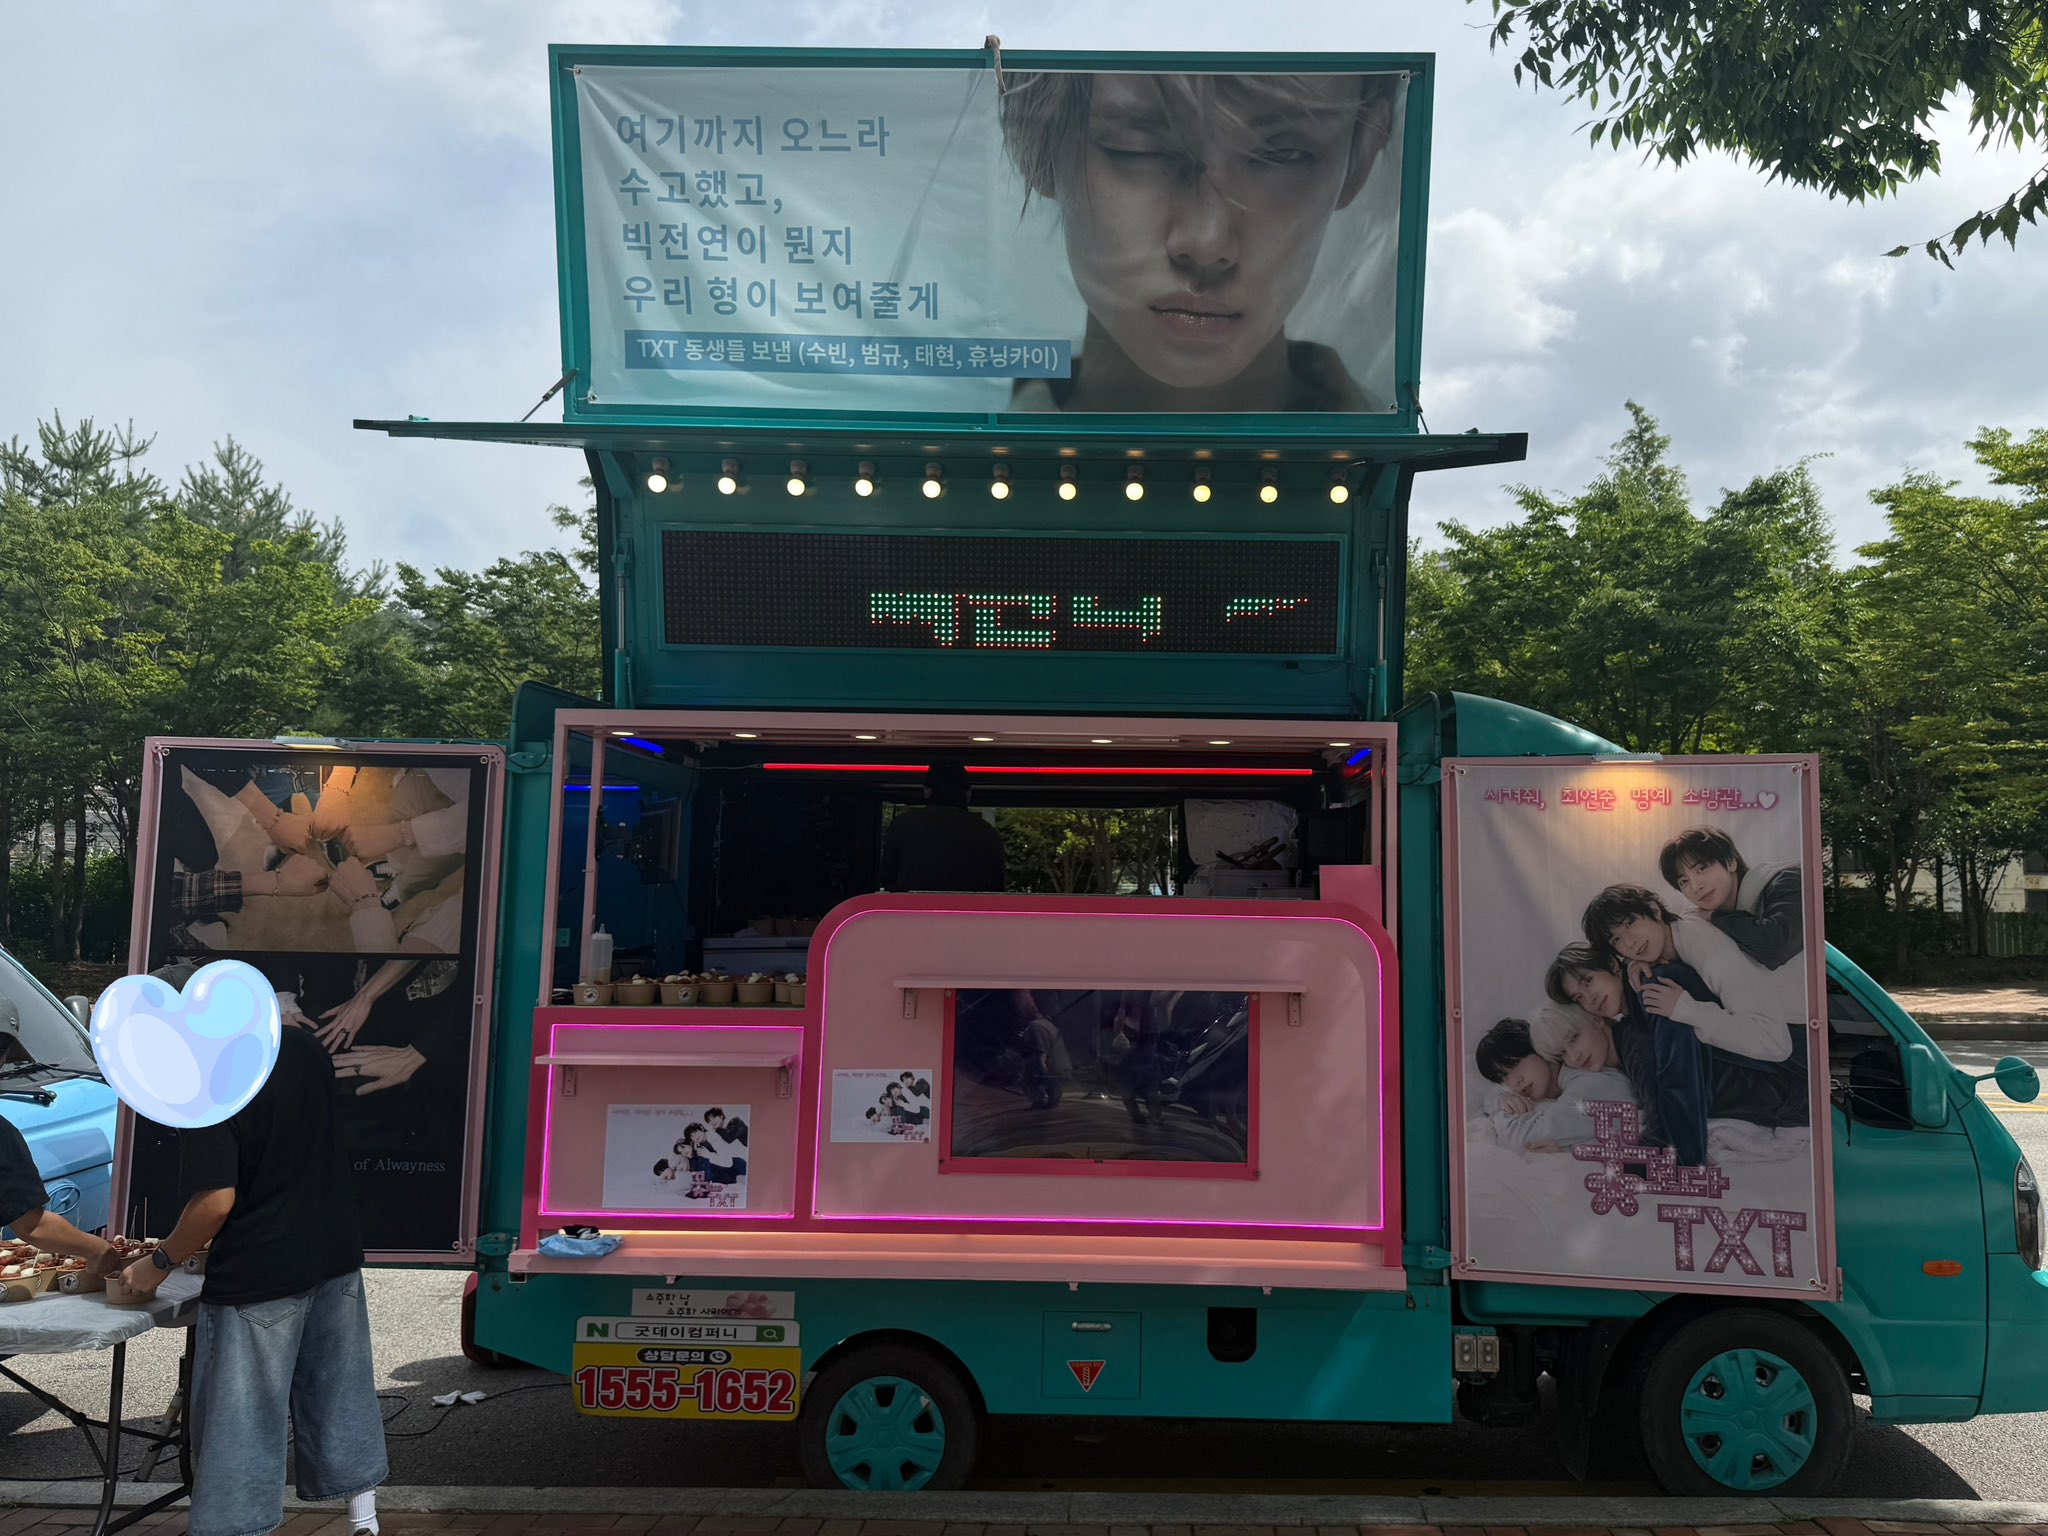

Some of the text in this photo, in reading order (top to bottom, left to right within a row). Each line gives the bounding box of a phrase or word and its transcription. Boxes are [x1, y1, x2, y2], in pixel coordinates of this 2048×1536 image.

[617, 114, 890, 157] 여기까지 오느라
[619, 167, 783, 214] 수고했고,
[622, 221, 852, 266] 빅전연이 뭔지
[623, 275, 939, 320] 우리 형이 보여줄게
[637, 338, 1059, 372] TXT 동생들 보냄 (수빈, 범규, 태현, 휴닝카이)
[1484, 786, 1758, 811] 시켜줘, 최연준 명예 소방관...
[353, 1157, 446, 1174] of Alwayness
[707, 1192, 739, 1208] TXT
[1657, 1203, 1807, 1278] TXT
[586, 1322, 609, 1338] N
[634, 1325, 738, 1339] 굿데이컴퍼니
[643, 1349, 705, 1362] 상담문의
[575, 1366, 796, 1414] 1555-1652
